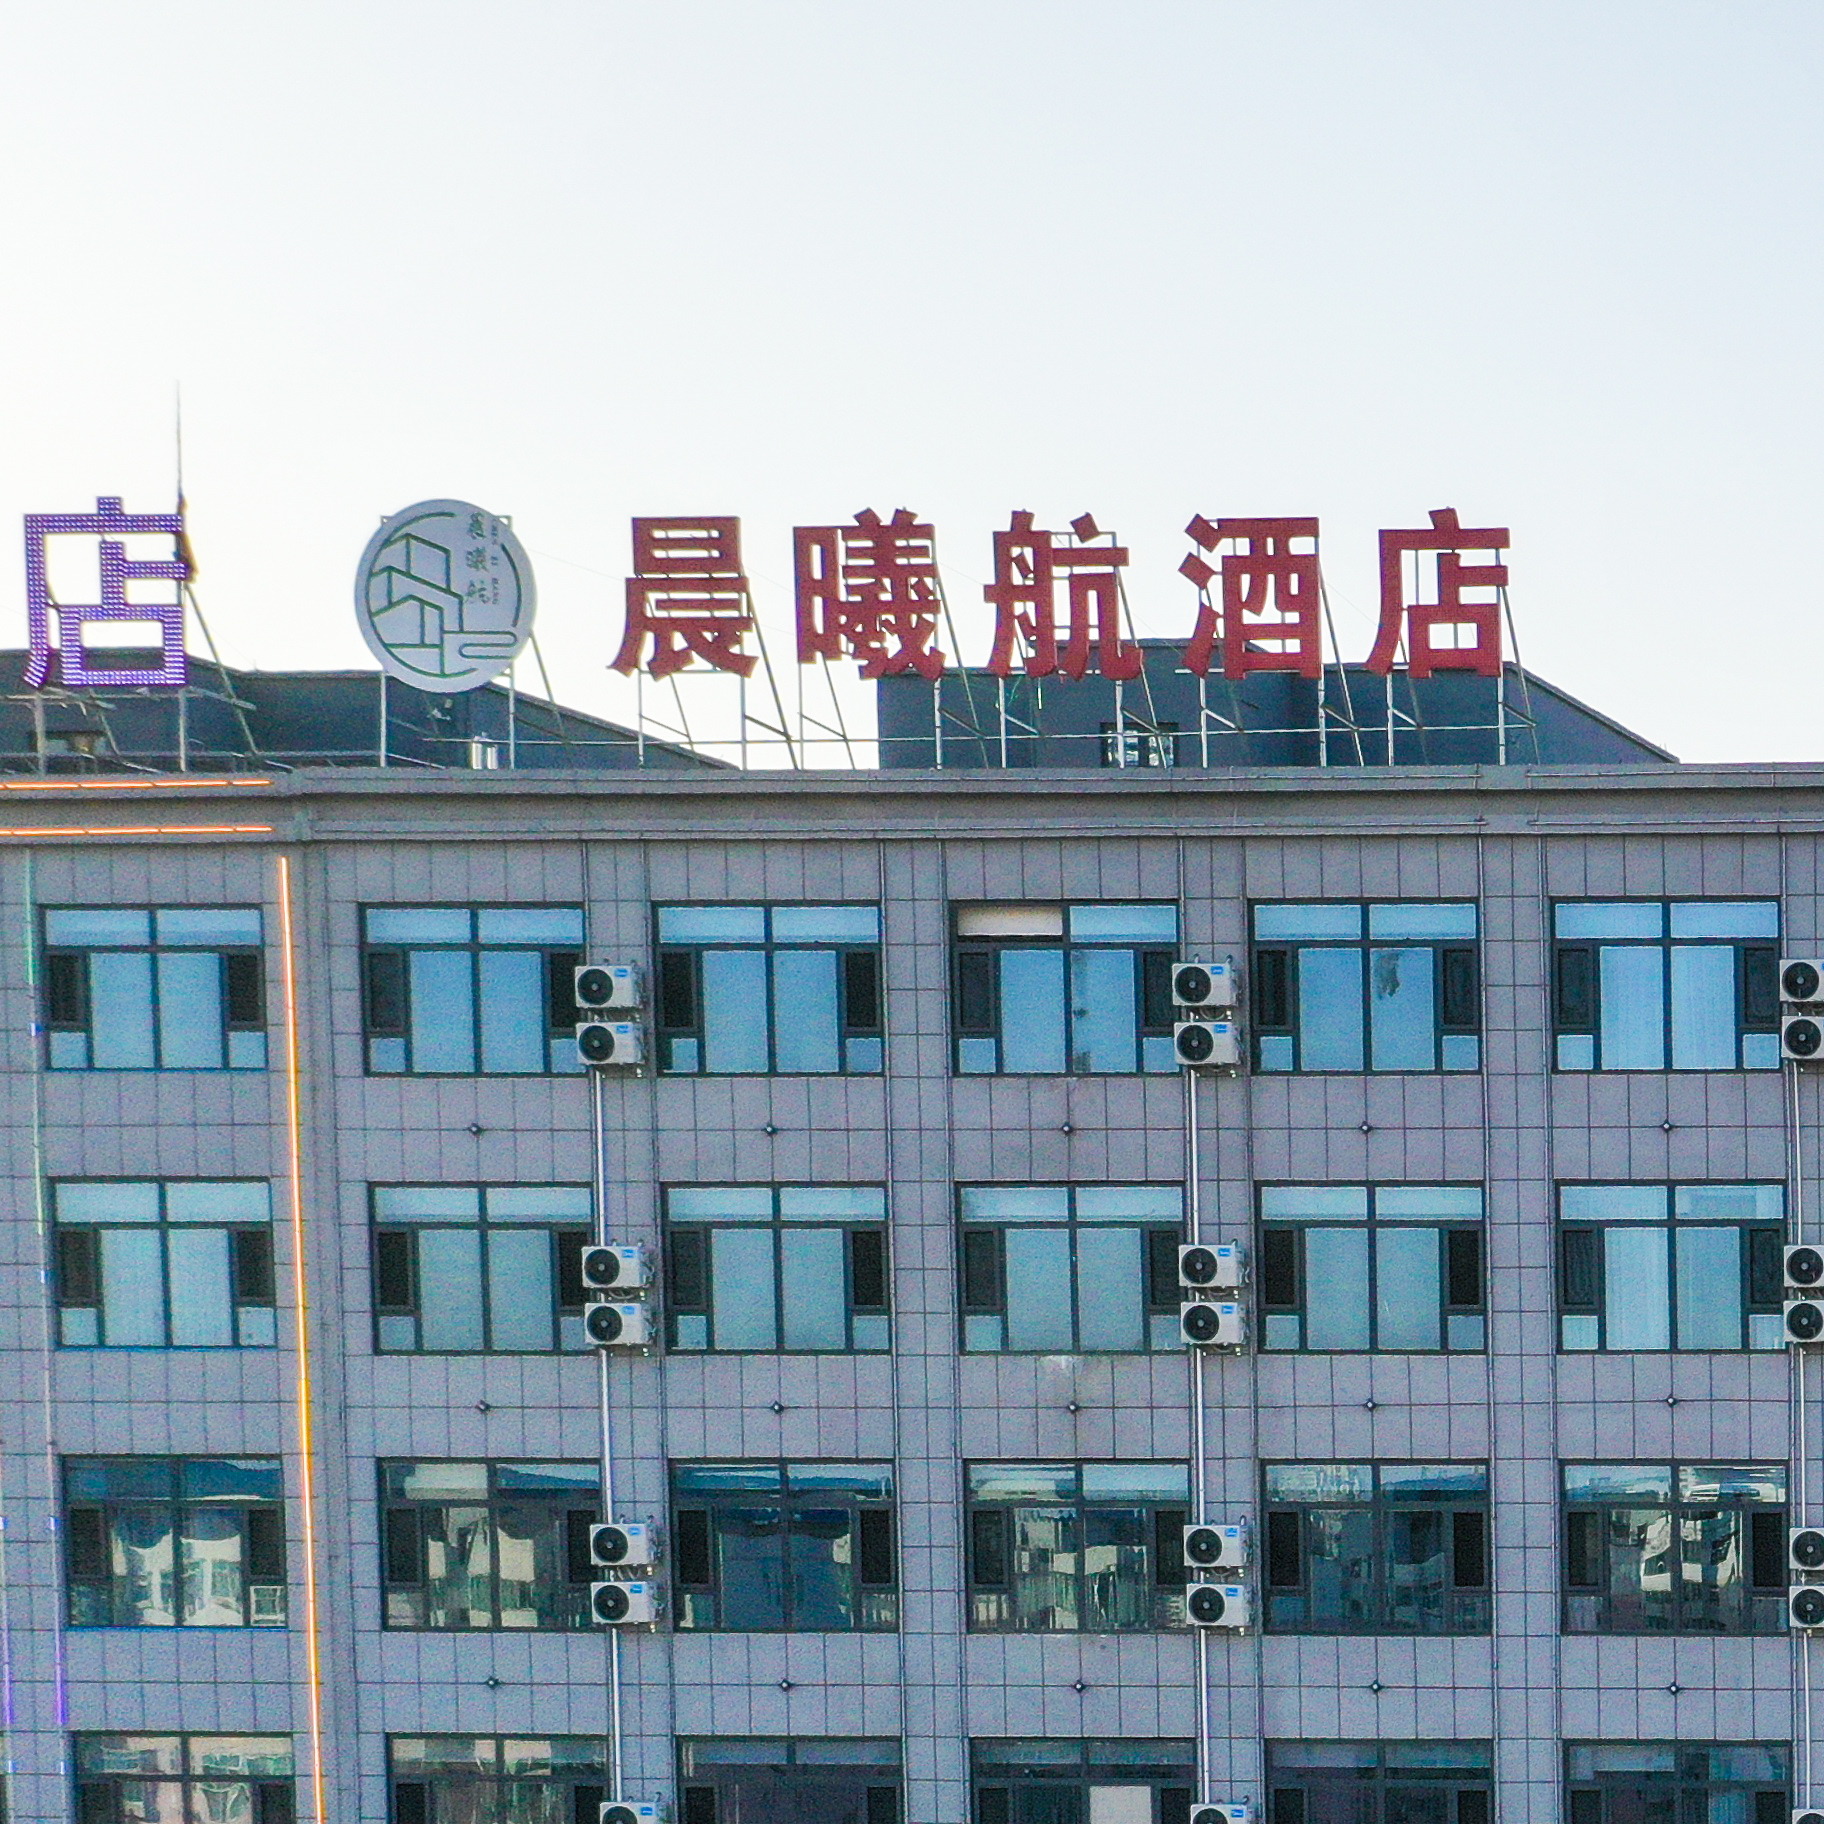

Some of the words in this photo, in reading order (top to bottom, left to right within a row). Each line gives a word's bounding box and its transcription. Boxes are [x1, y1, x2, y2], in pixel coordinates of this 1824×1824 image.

[23, 495, 188, 689] 店
[611, 507, 1512, 680] 晨曦航酒店
